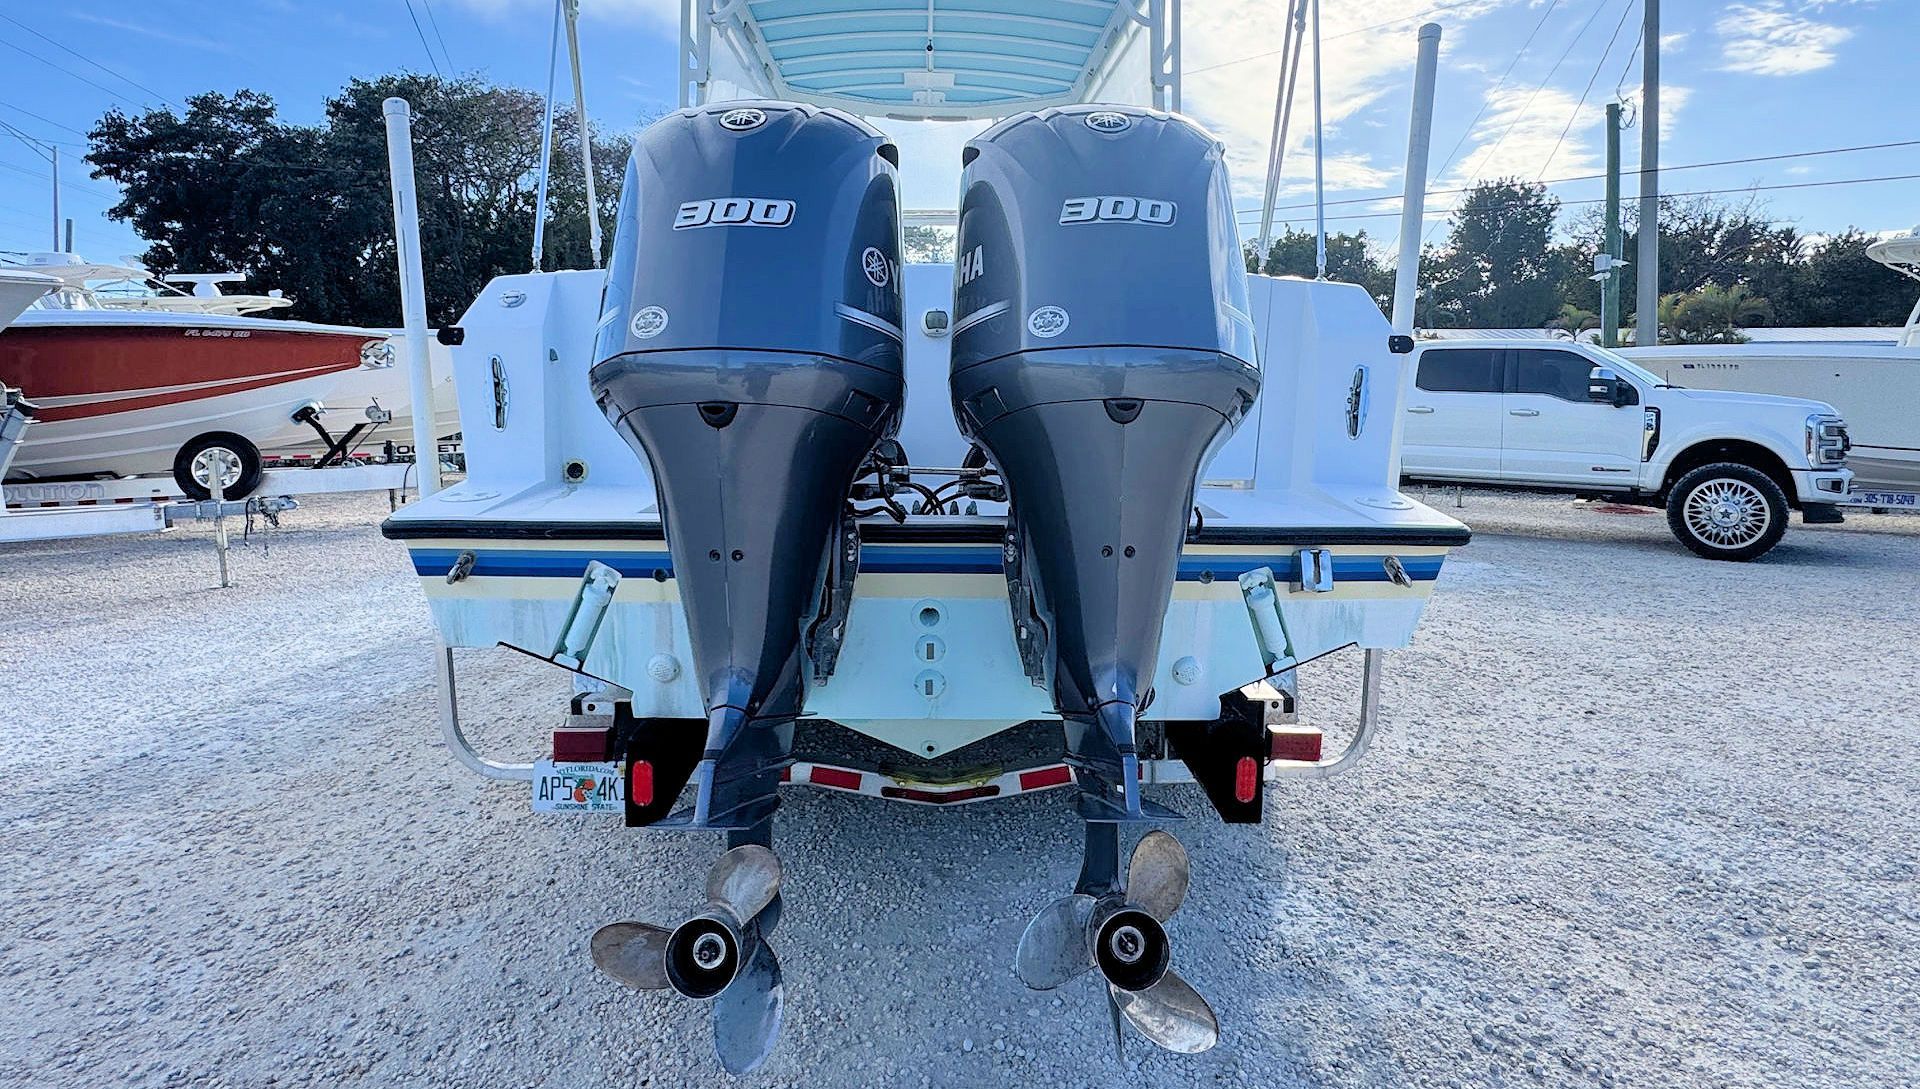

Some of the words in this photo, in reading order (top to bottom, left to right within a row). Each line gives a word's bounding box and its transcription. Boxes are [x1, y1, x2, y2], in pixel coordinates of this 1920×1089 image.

[674, 198, 796, 230] 300
[1060, 197, 1177, 227] 300
[539, 776, 573, 800] AP5
[554, 803, 588, 811] SUNSHINE
[592, 803, 613, 811] STATE
